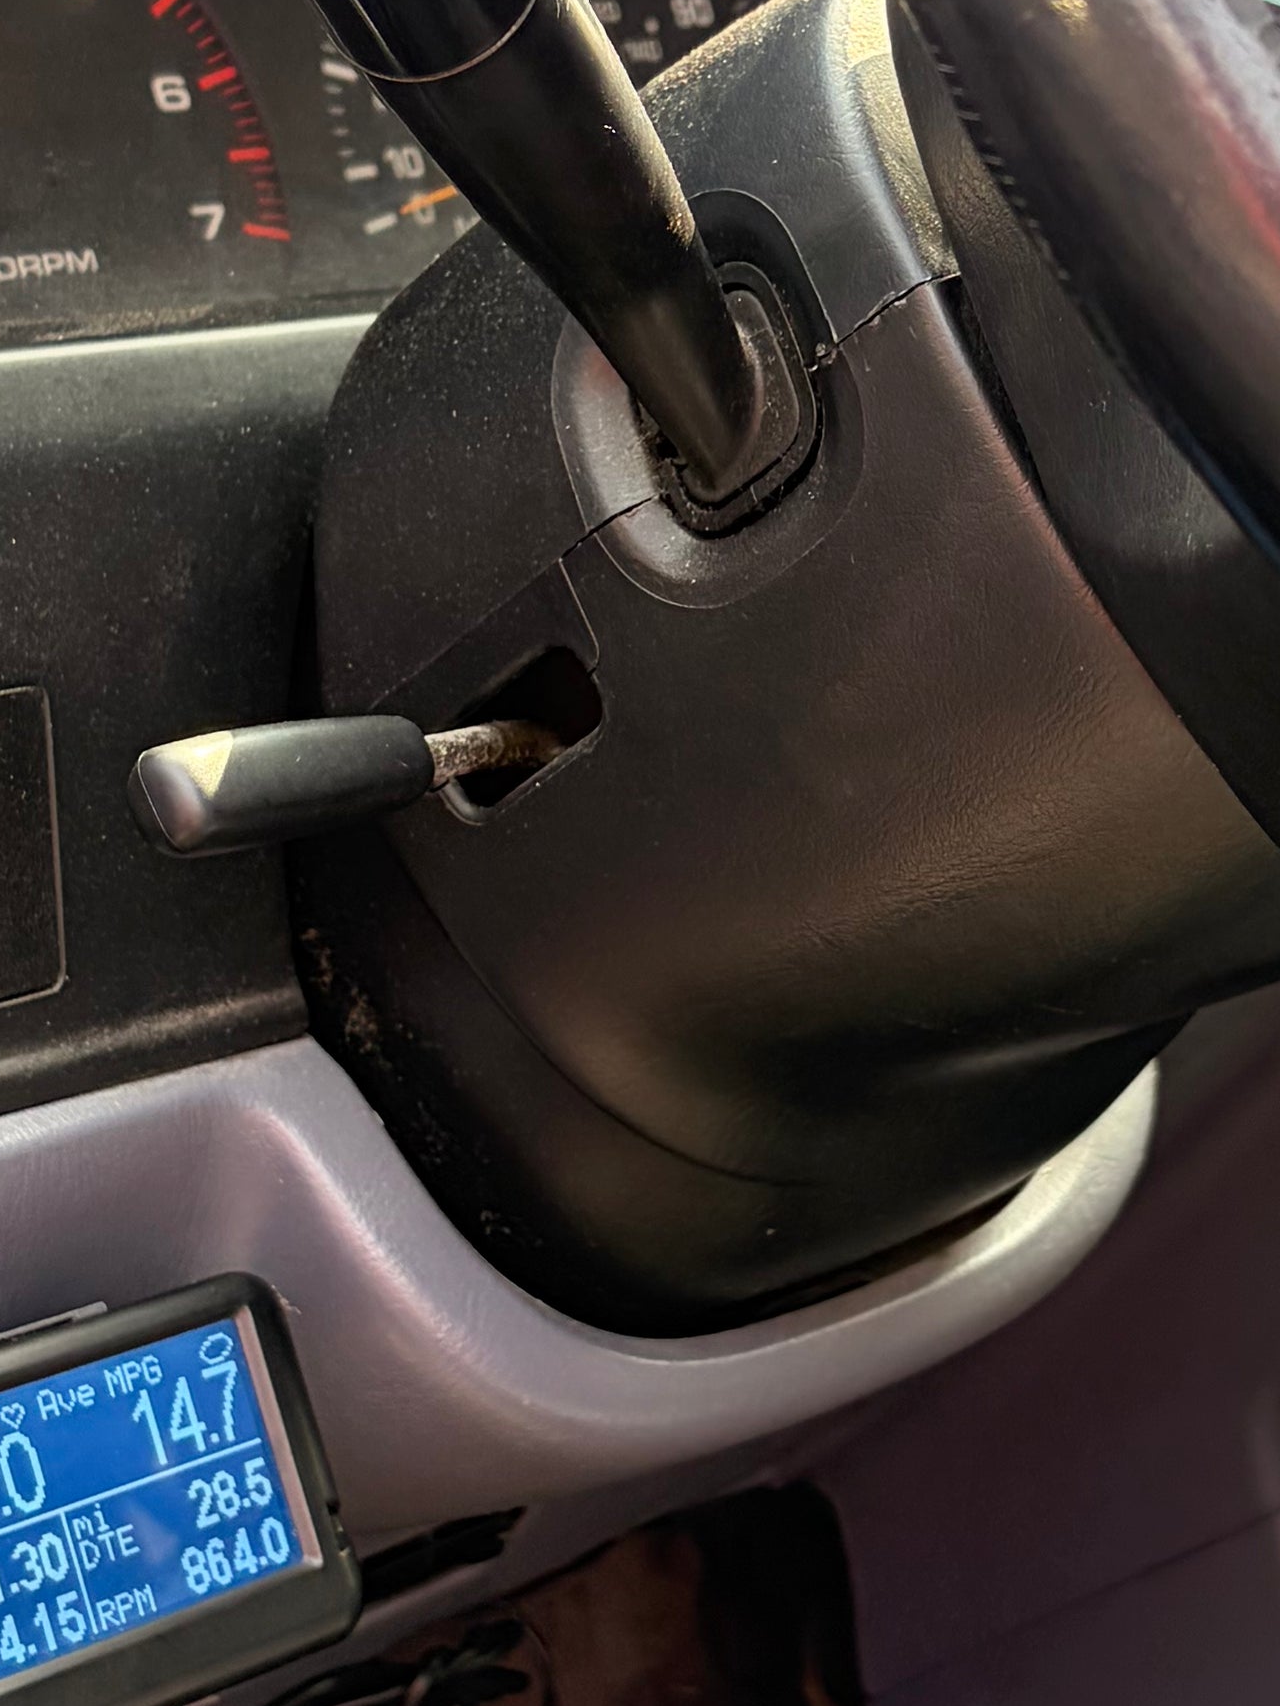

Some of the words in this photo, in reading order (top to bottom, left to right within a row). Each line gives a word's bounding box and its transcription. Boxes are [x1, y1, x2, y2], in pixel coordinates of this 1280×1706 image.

[150, 74, 192, 113] 6
[383, 146, 425, 179] 10
[188, 203, 226, 240] 7
[37, 1384, 95, 1421] Ave
[103, 1355, 163, 1399] MPG
[131, 1361, 239, 1467] 14.7
[187, 1458, 274, 1529] 28.5
[72, 1504, 111, 1537] mi
[80, 1524, 140, 1571] DTE
[180, 1517, 290, 1594] 864.0
[95, 1587, 157, 1631] RPM
